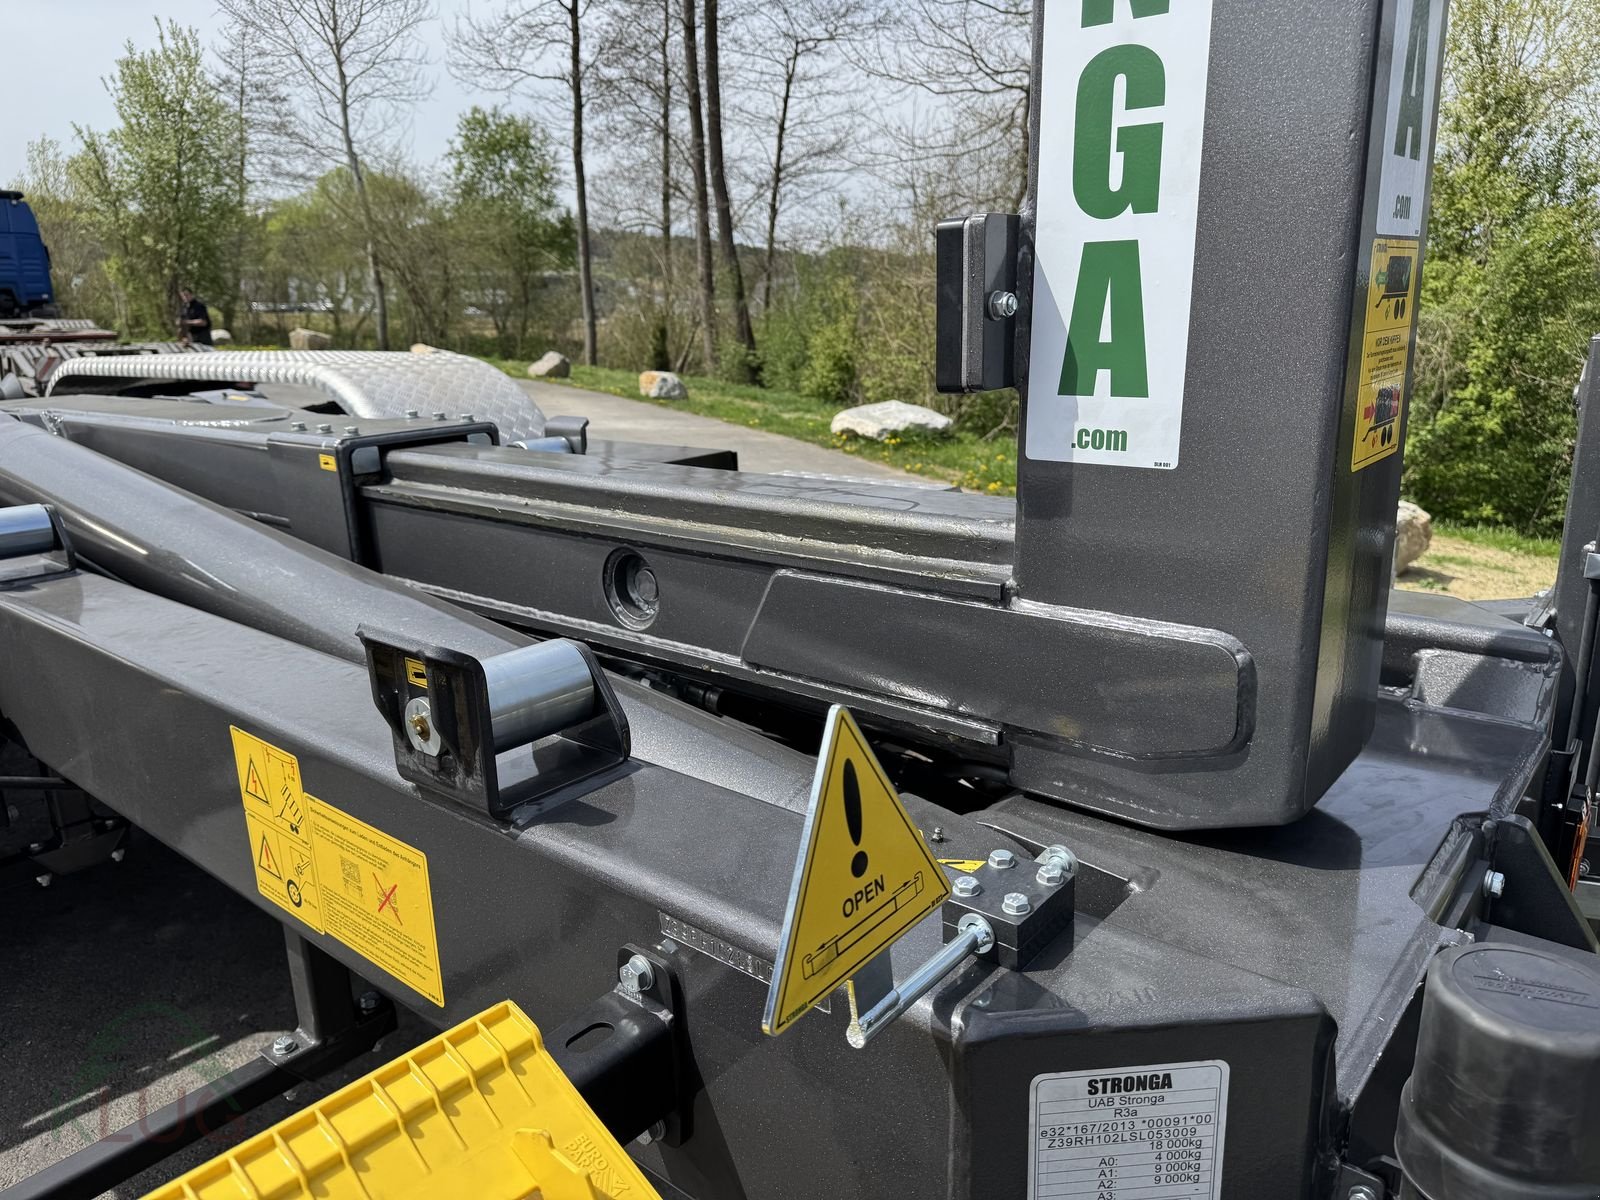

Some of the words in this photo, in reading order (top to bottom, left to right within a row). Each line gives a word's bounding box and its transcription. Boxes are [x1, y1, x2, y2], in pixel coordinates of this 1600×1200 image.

[1056, 0, 1170, 398] GA
[1393, 194, 1411, 220] .com
[1071, 428, 1128, 452] .com
[842, 874, 885, 918] OPEN
[1087, 1073, 1173, 1096] STRONGA
[1088, 1097, 1115, 1109] UAB
[1119, 1094, 1165, 1107] Stronga
[1113, 1109, 1138, 1118] R3a
[1047, 1127, 1198, 1149] Z39RH102LSL053009
[1150, 1141, 1163, 1150] 18
[1167, 1138, 1202, 1149] 000kg
[575, 1133, 609, 1171] EURO
[1098, 1157, 1118, 1167] A0:
[1155, 1153, 1162, 1161] 4
[1166, 1150, 1202, 1161] 000kg
[1098, 1169, 1118, 1178] A1:
[1154, 1164, 1162, 1173] 9
[1165, 1161, 1201, 1172] 000kg
[1097, 1180, 1117, 1190] A2:
[1154, 1176, 1161, 1185] 9
[1165, 1173, 1200, 1184] 000kg
[1097, 1192, 1116, 1200] A3:
